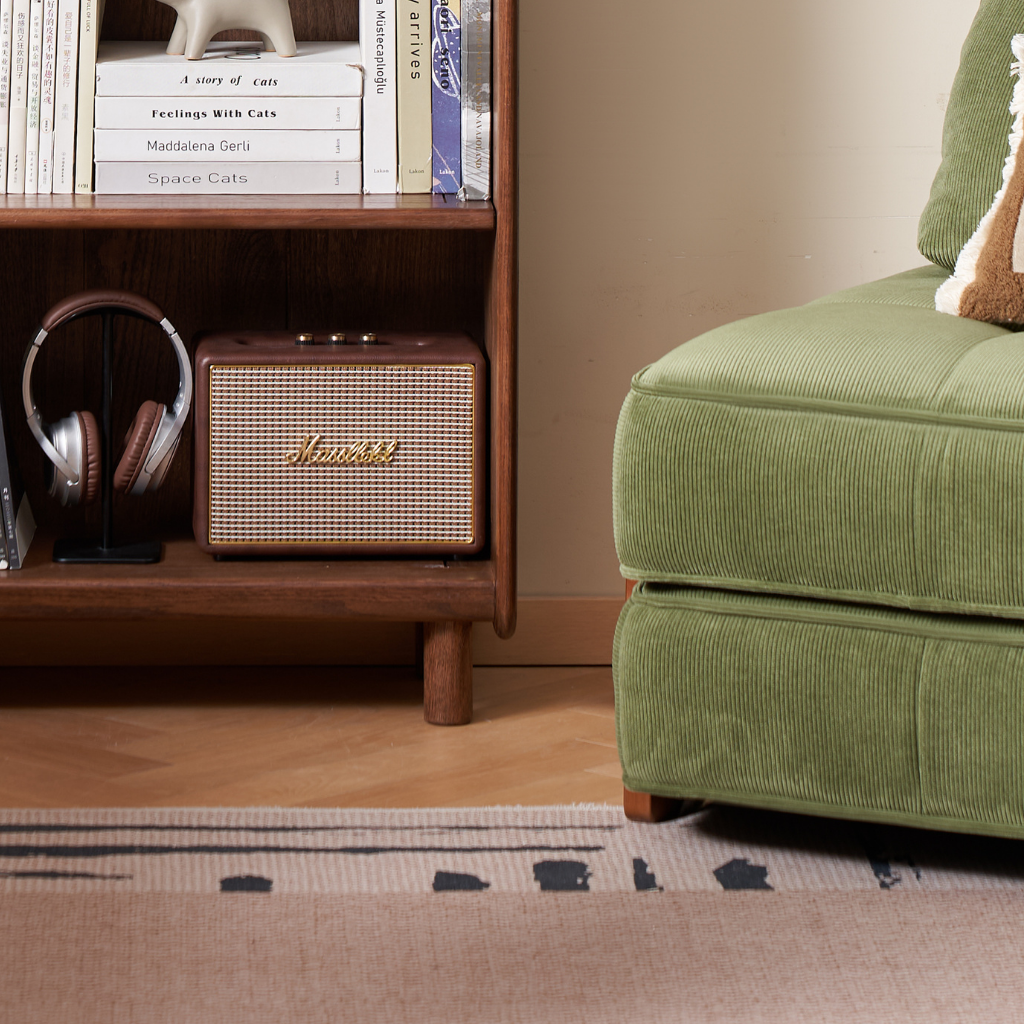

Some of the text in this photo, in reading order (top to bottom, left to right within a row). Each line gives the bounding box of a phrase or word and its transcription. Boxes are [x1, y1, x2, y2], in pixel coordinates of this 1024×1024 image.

[374, 10, 387, 94] Müstecaplıoğlu
[410, 12, 423, 80] arrives
[440, 47, 450, 89] seno
[180, 75, 189, 84] A
[195, 76, 223, 86] story
[230, 75, 243, 86] of
[152, 109, 277, 120] Feelings With Cats
[147, 140, 250, 151] Maddalena Gerli
[148, 172, 248, 186] Space Cats
